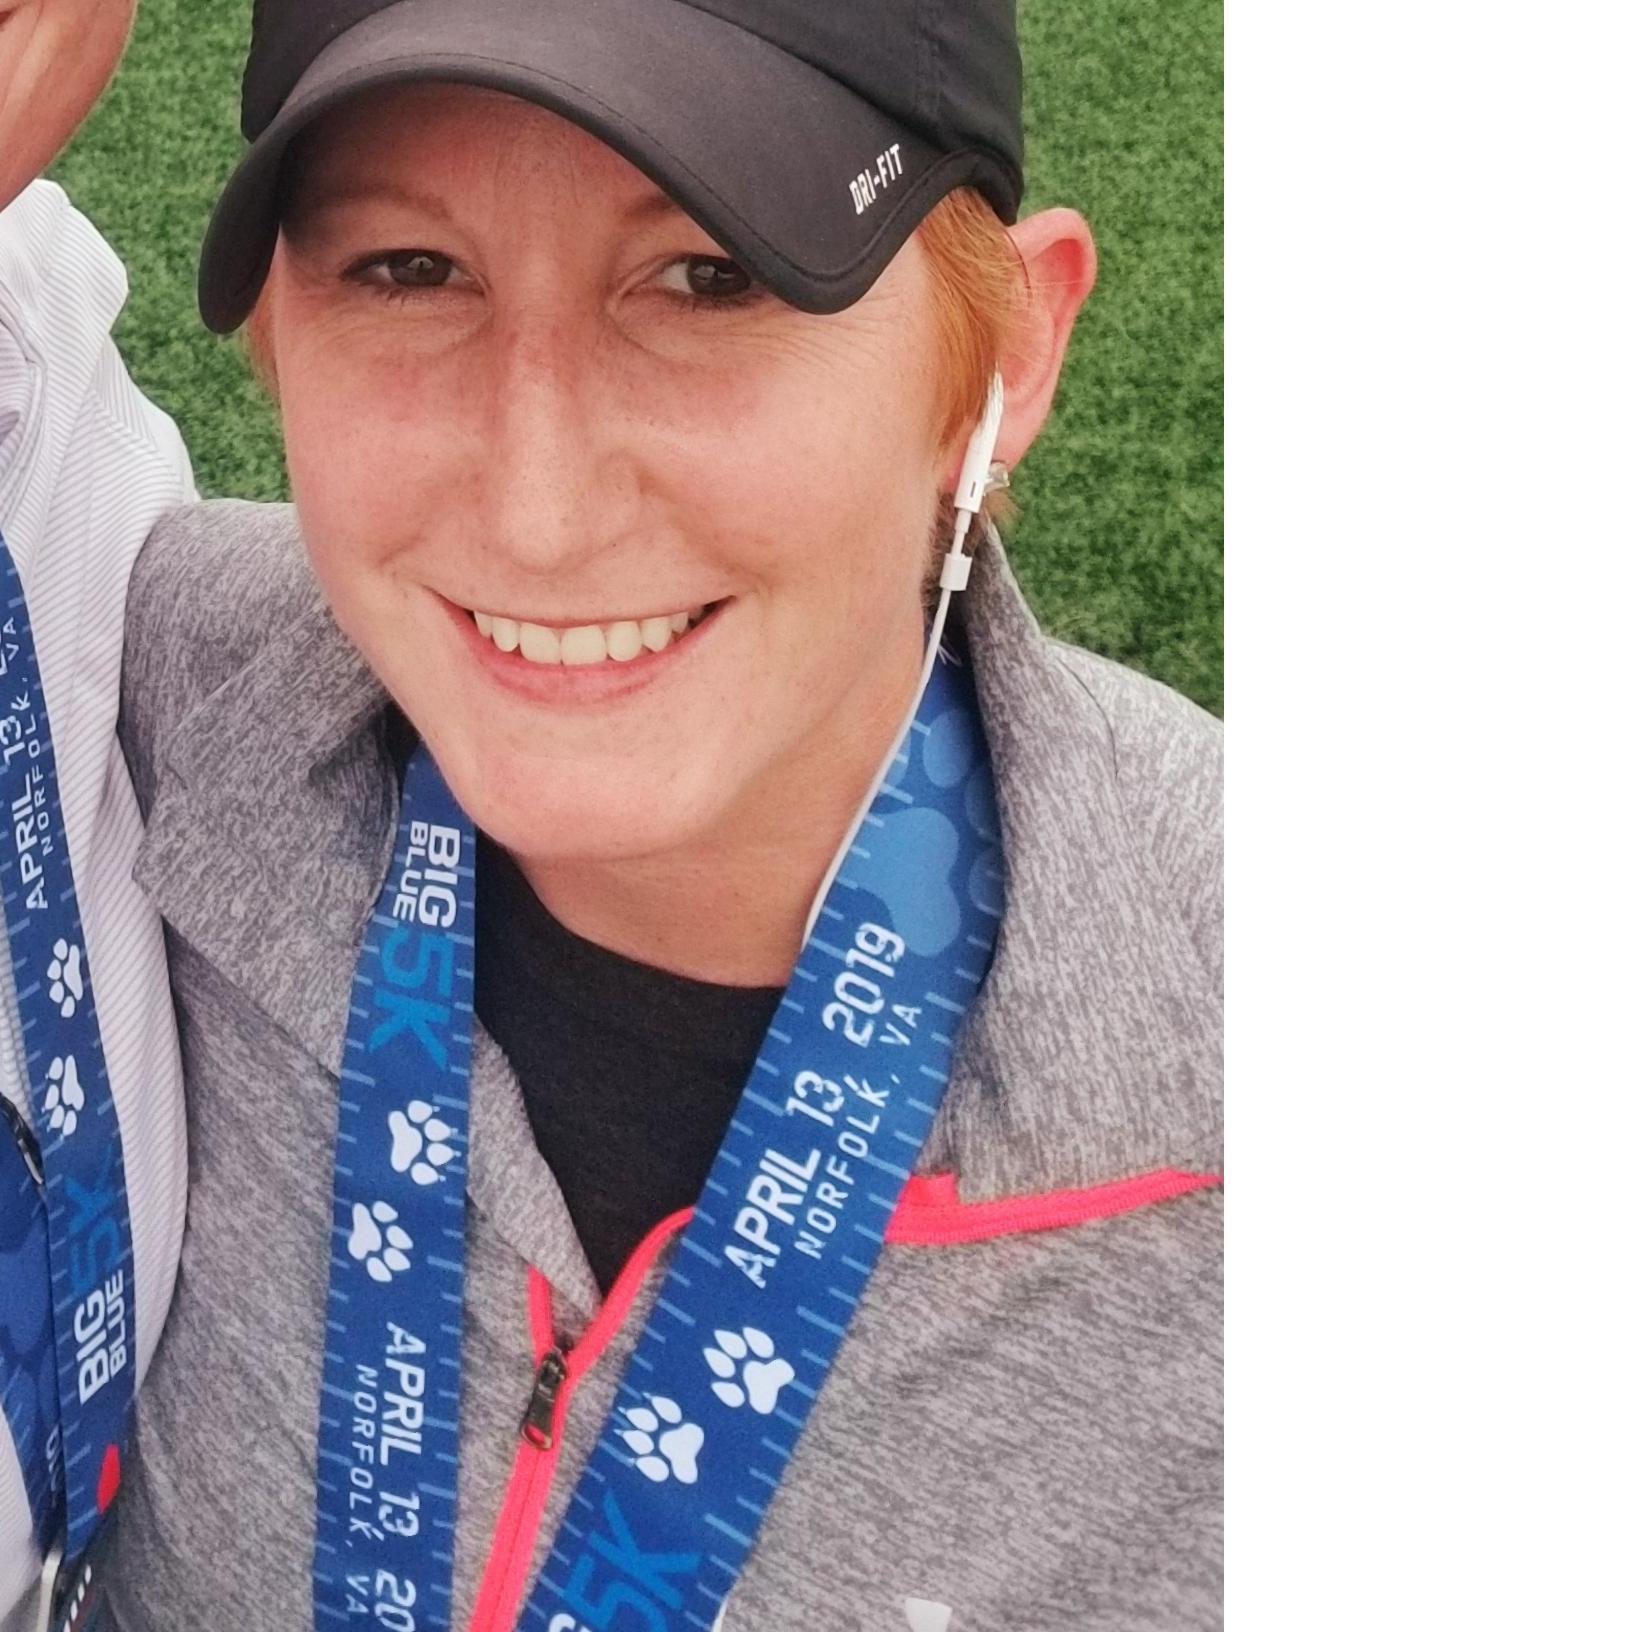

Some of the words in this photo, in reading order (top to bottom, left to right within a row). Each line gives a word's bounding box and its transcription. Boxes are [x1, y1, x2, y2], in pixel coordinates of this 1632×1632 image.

[849, 143, 903, 215] DRI-FIT
[3, 617, 20, 661] VA
[13, 773, 48, 909] APRIL
[392, 820, 429, 923] BLUE
[418, 824, 461, 929] BIG
[369, 925, 455, 1071] 5K
[879, 1003, 922, 1047] VA
[724, 1149, 821, 1289] APRIL
[785, 1070, 845, 1127] 13
[822, 922, 906, 1048] 2019
[65, 1143, 121, 1295] 5K
[74, 1289, 110, 1406] BIG
[105, 1269, 128, 1379] BLUE
[379, 1321, 427, 1466] APRIL
[378, 1490, 421, 1538] 13
[565, 1490, 702, 1632] 5K
[346, 1574, 370, 1615] VA
